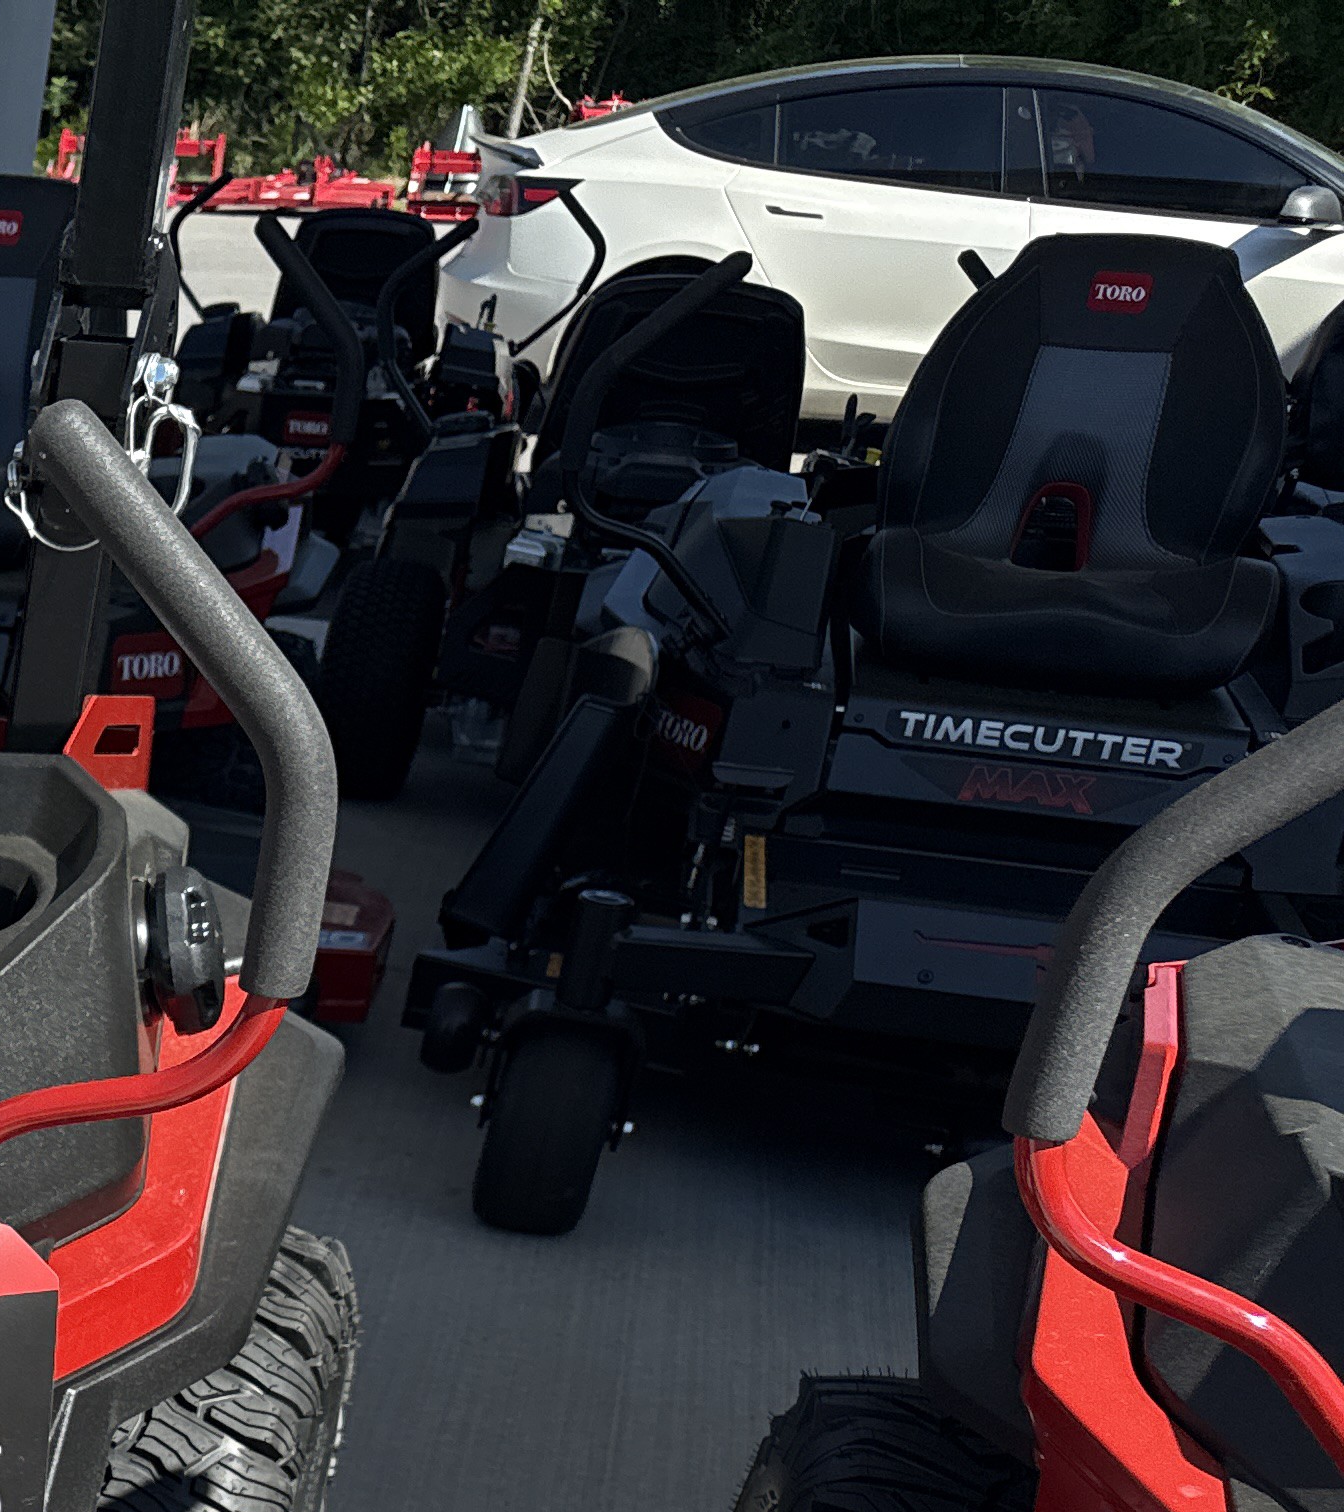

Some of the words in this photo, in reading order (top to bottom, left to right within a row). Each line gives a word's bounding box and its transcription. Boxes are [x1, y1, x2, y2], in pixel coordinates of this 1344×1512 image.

[1094, 283, 1146, 302] TORO
[117, 651, 181, 681] TORO
[899, 710, 1184, 769] TIMECUTTER
[956, 765, 1097, 815] MAX
